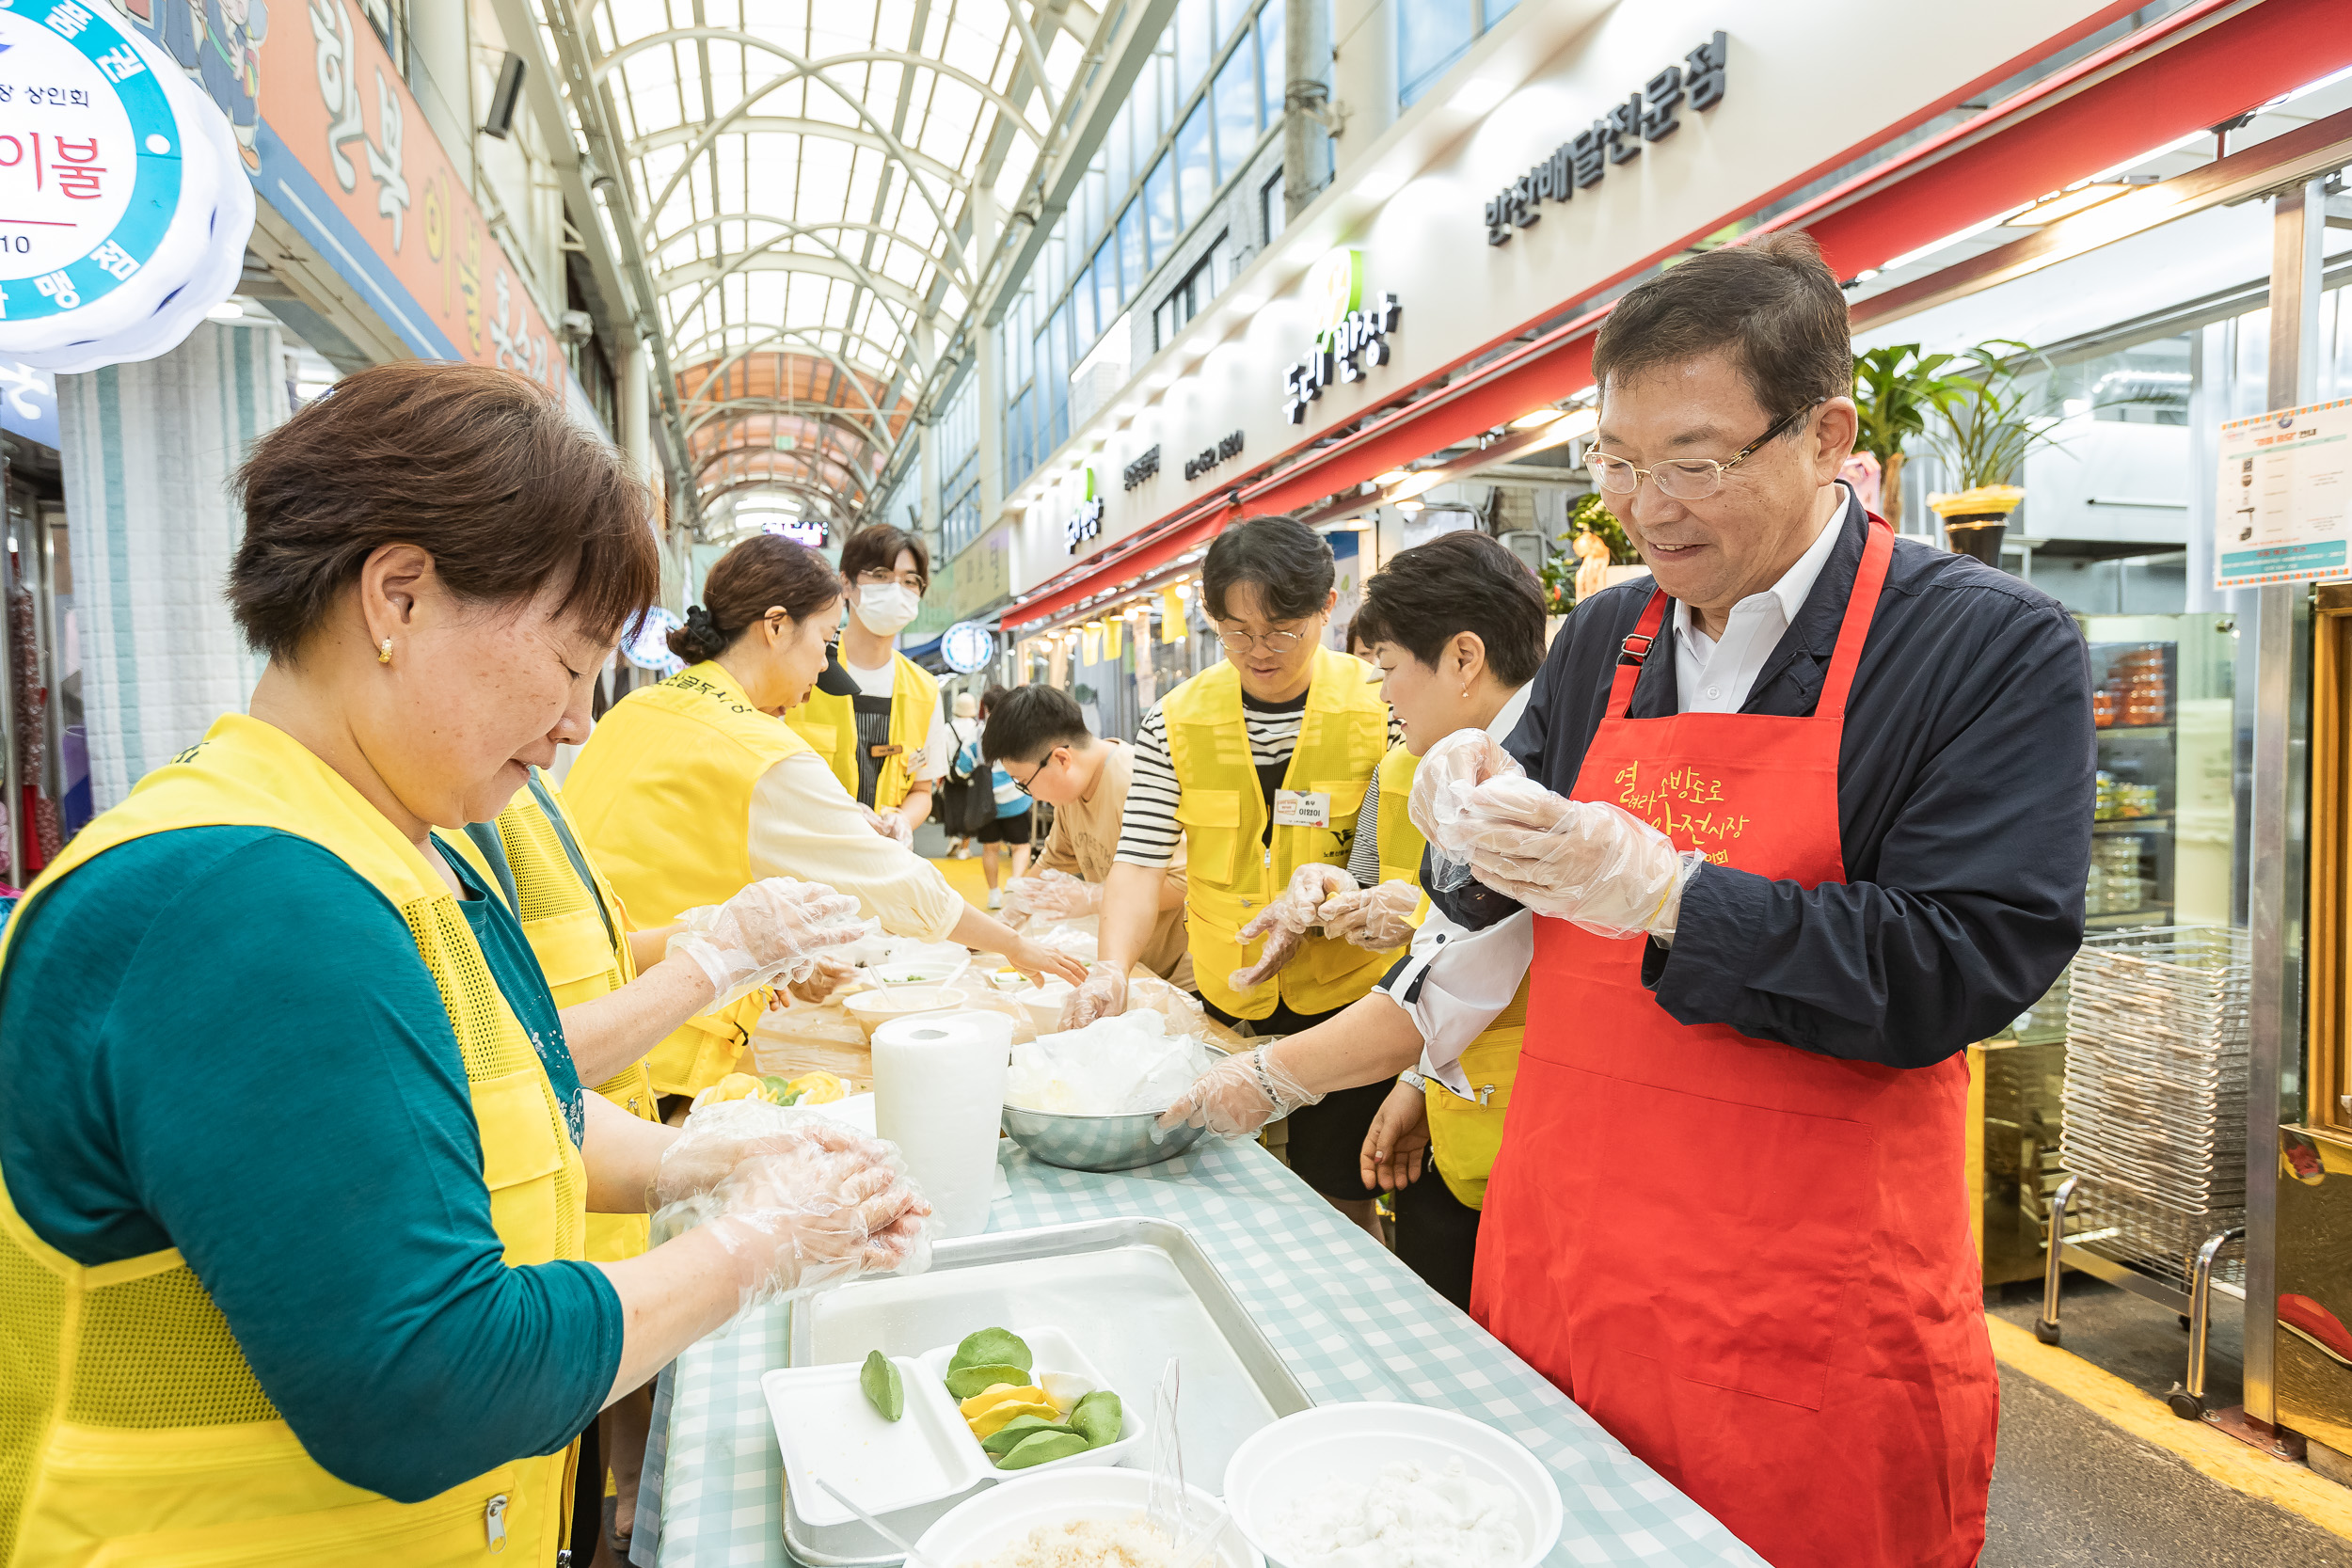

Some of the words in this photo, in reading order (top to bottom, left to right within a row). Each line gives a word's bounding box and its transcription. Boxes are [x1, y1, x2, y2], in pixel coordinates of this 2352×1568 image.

[24, 86, 89, 108] 상인회
[0, 131, 107, 199] 이불
[1658, 766, 1724, 803] 소방도로
